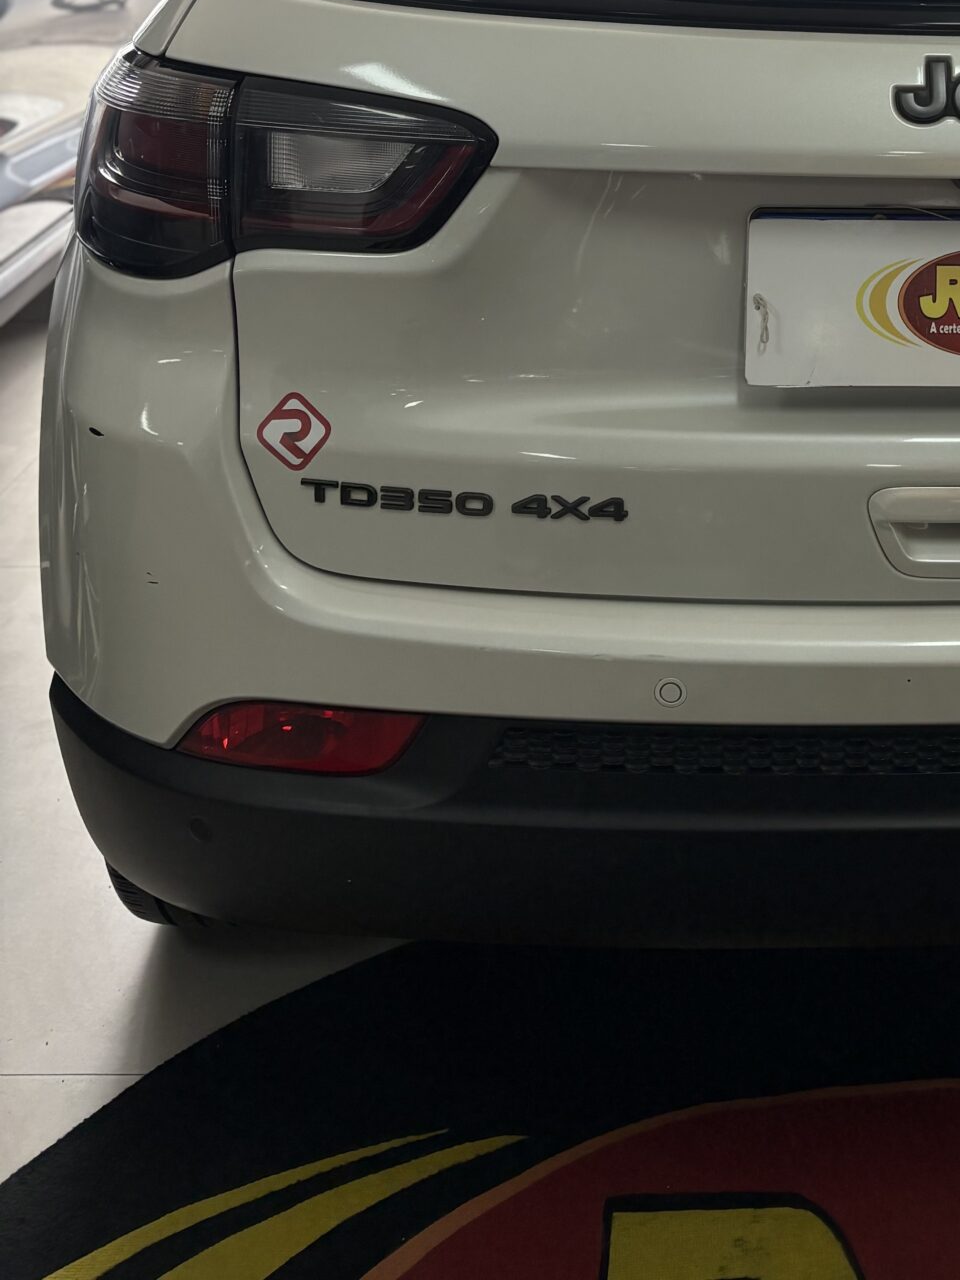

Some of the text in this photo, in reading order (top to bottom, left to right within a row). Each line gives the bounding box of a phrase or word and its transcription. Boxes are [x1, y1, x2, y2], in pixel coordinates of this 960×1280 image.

[929, 322, 938, 334] A
[300, 477, 630, 522] TD350 4X4
